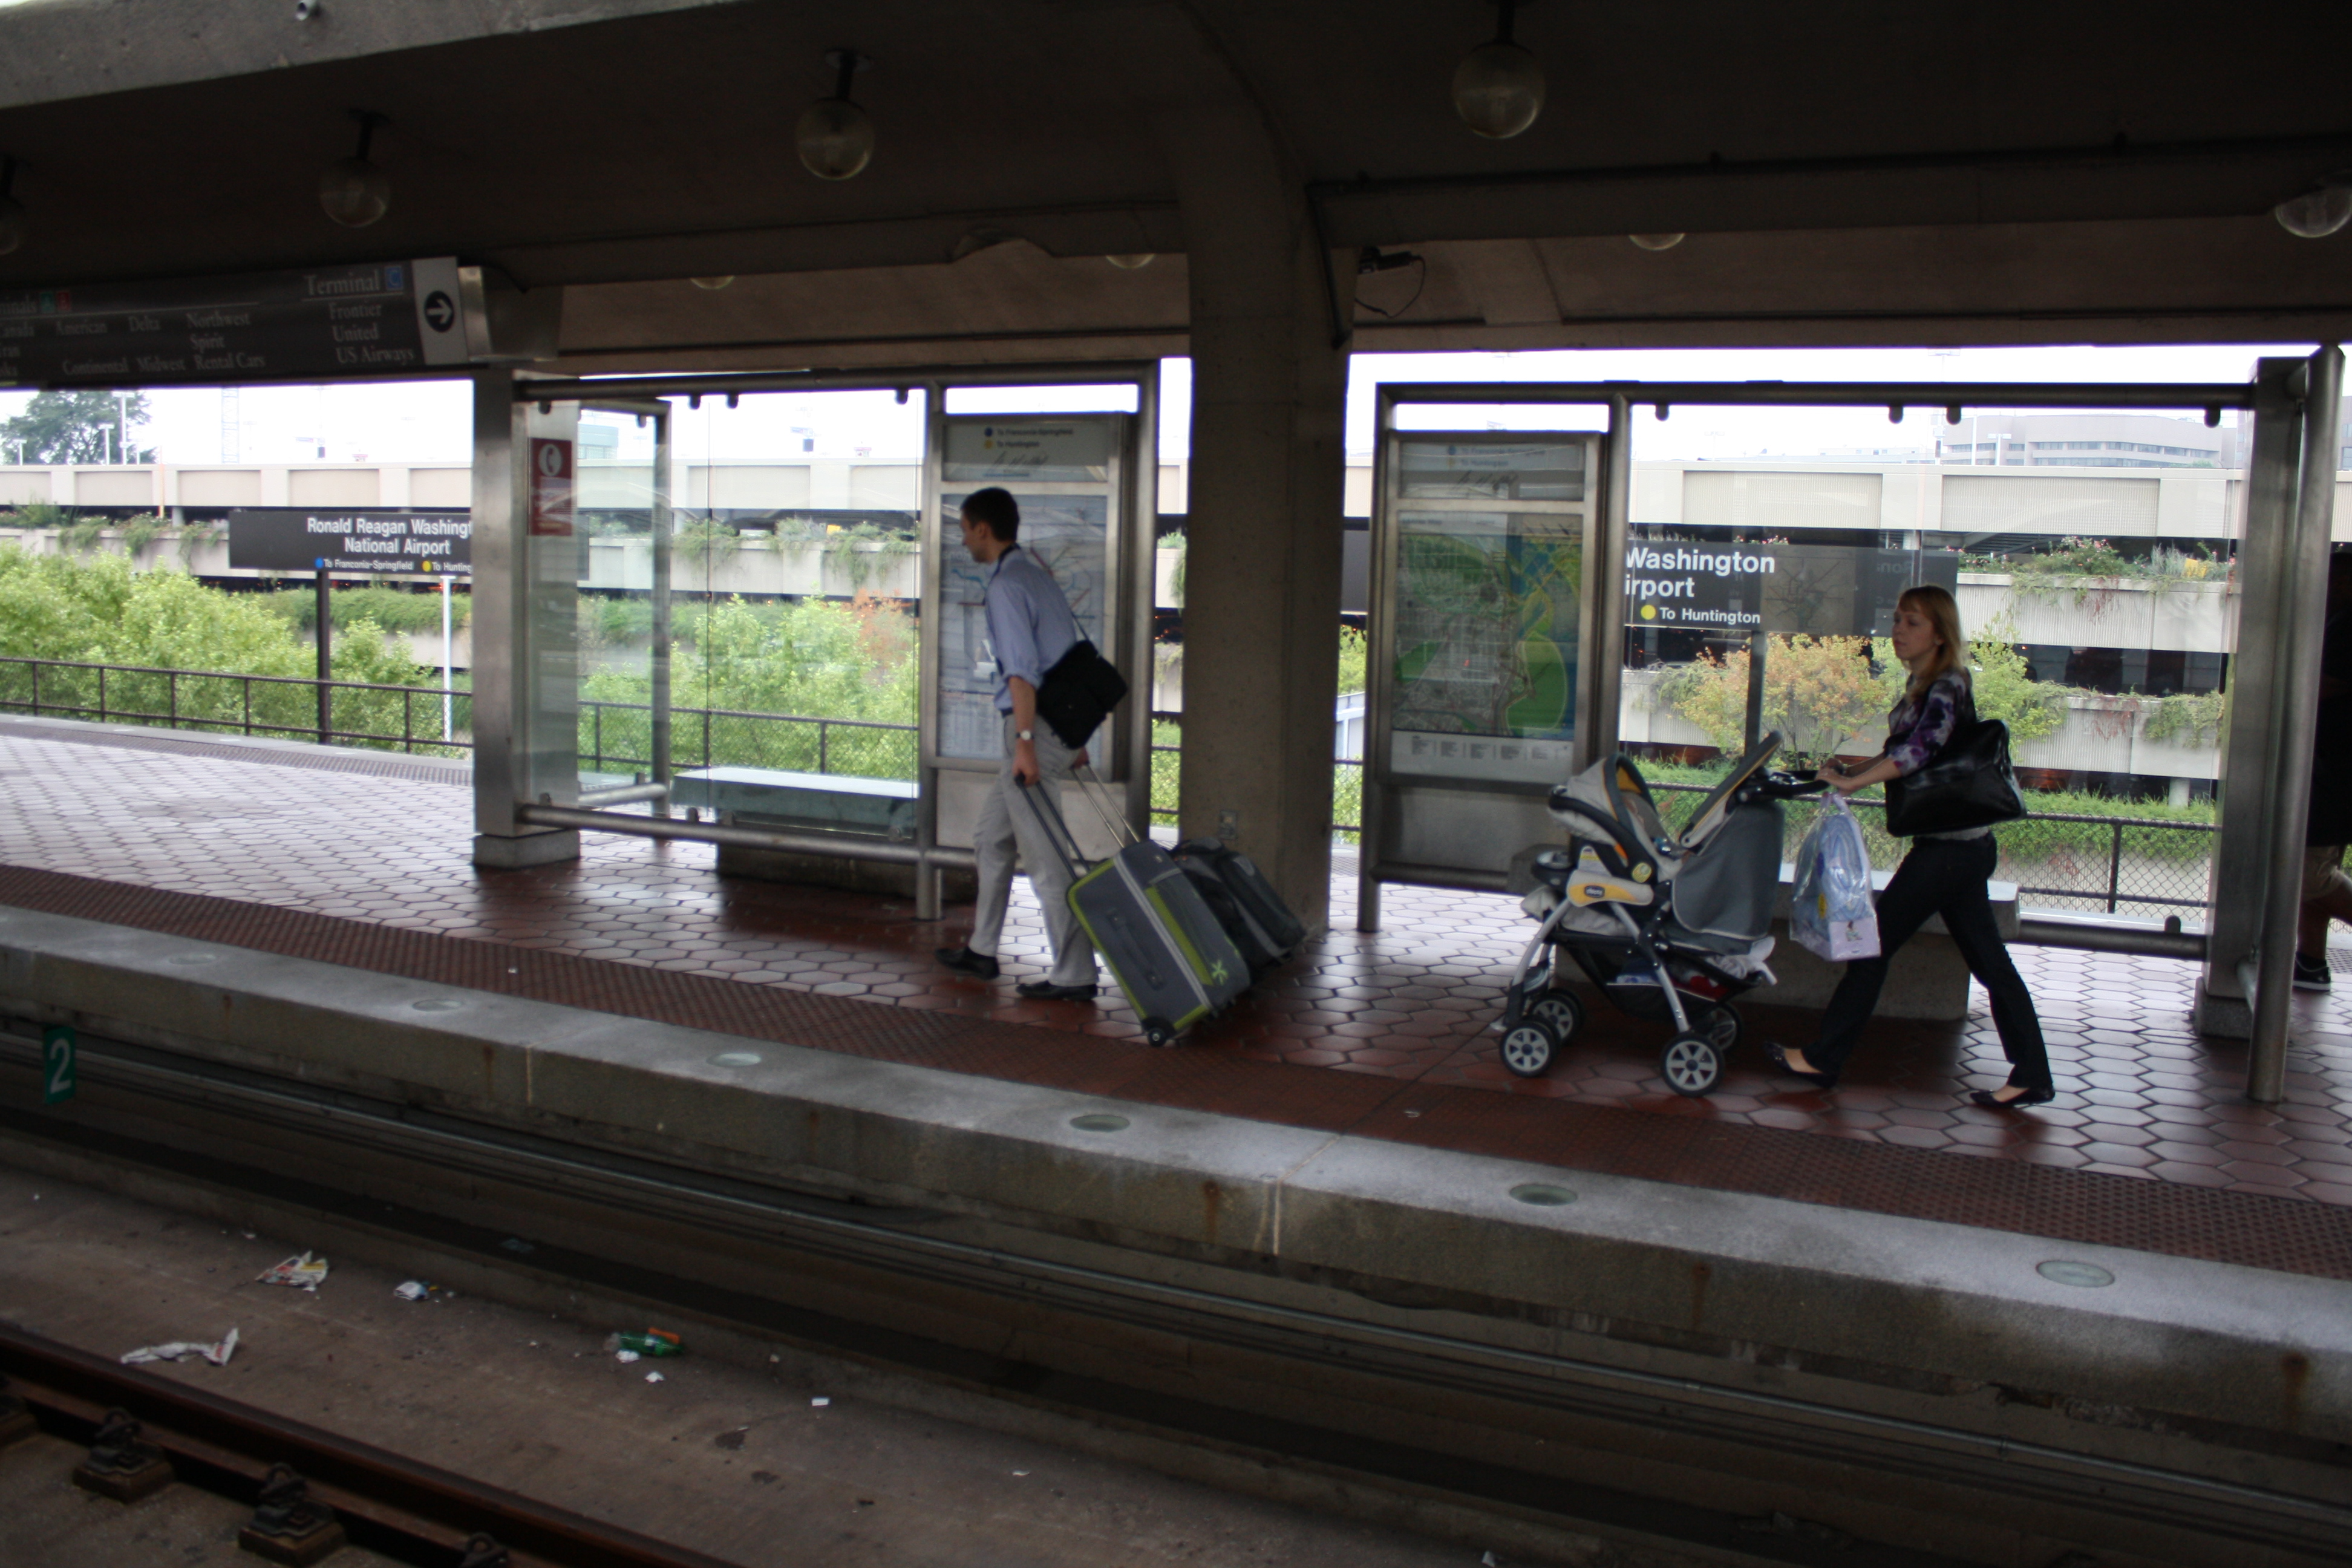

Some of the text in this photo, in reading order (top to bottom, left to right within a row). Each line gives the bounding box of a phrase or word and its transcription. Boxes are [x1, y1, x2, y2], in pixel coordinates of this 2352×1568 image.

[304, 269, 400, 296] Terminal C
[186, 310, 250, 328] Northwest
[328, 301, 382, 320] Frontier
[56, 319, 108, 335] American
[128, 315, 160, 332] Delta
[333, 322, 379, 342] United
[189, 333, 226, 354] Spirit
[136, 355, 186, 373] Midwest
[194, 352, 266, 370] Rental Cars
[336, 345, 414, 366] US Airways
[62, 358, 129, 376] Continental
[307, 517, 353, 534] Ronald
[356, 518, 407, 537] Reagan
[344, 537, 451, 557] National Airport
[324, 558, 414, 572] To Franconia-Springfield
[432, 561, 442, 571] To
[1625, 546, 1776, 577] Washington
[1659, 607, 1761, 625] To Huntington
[48, 1036, 73, 1095] 2
